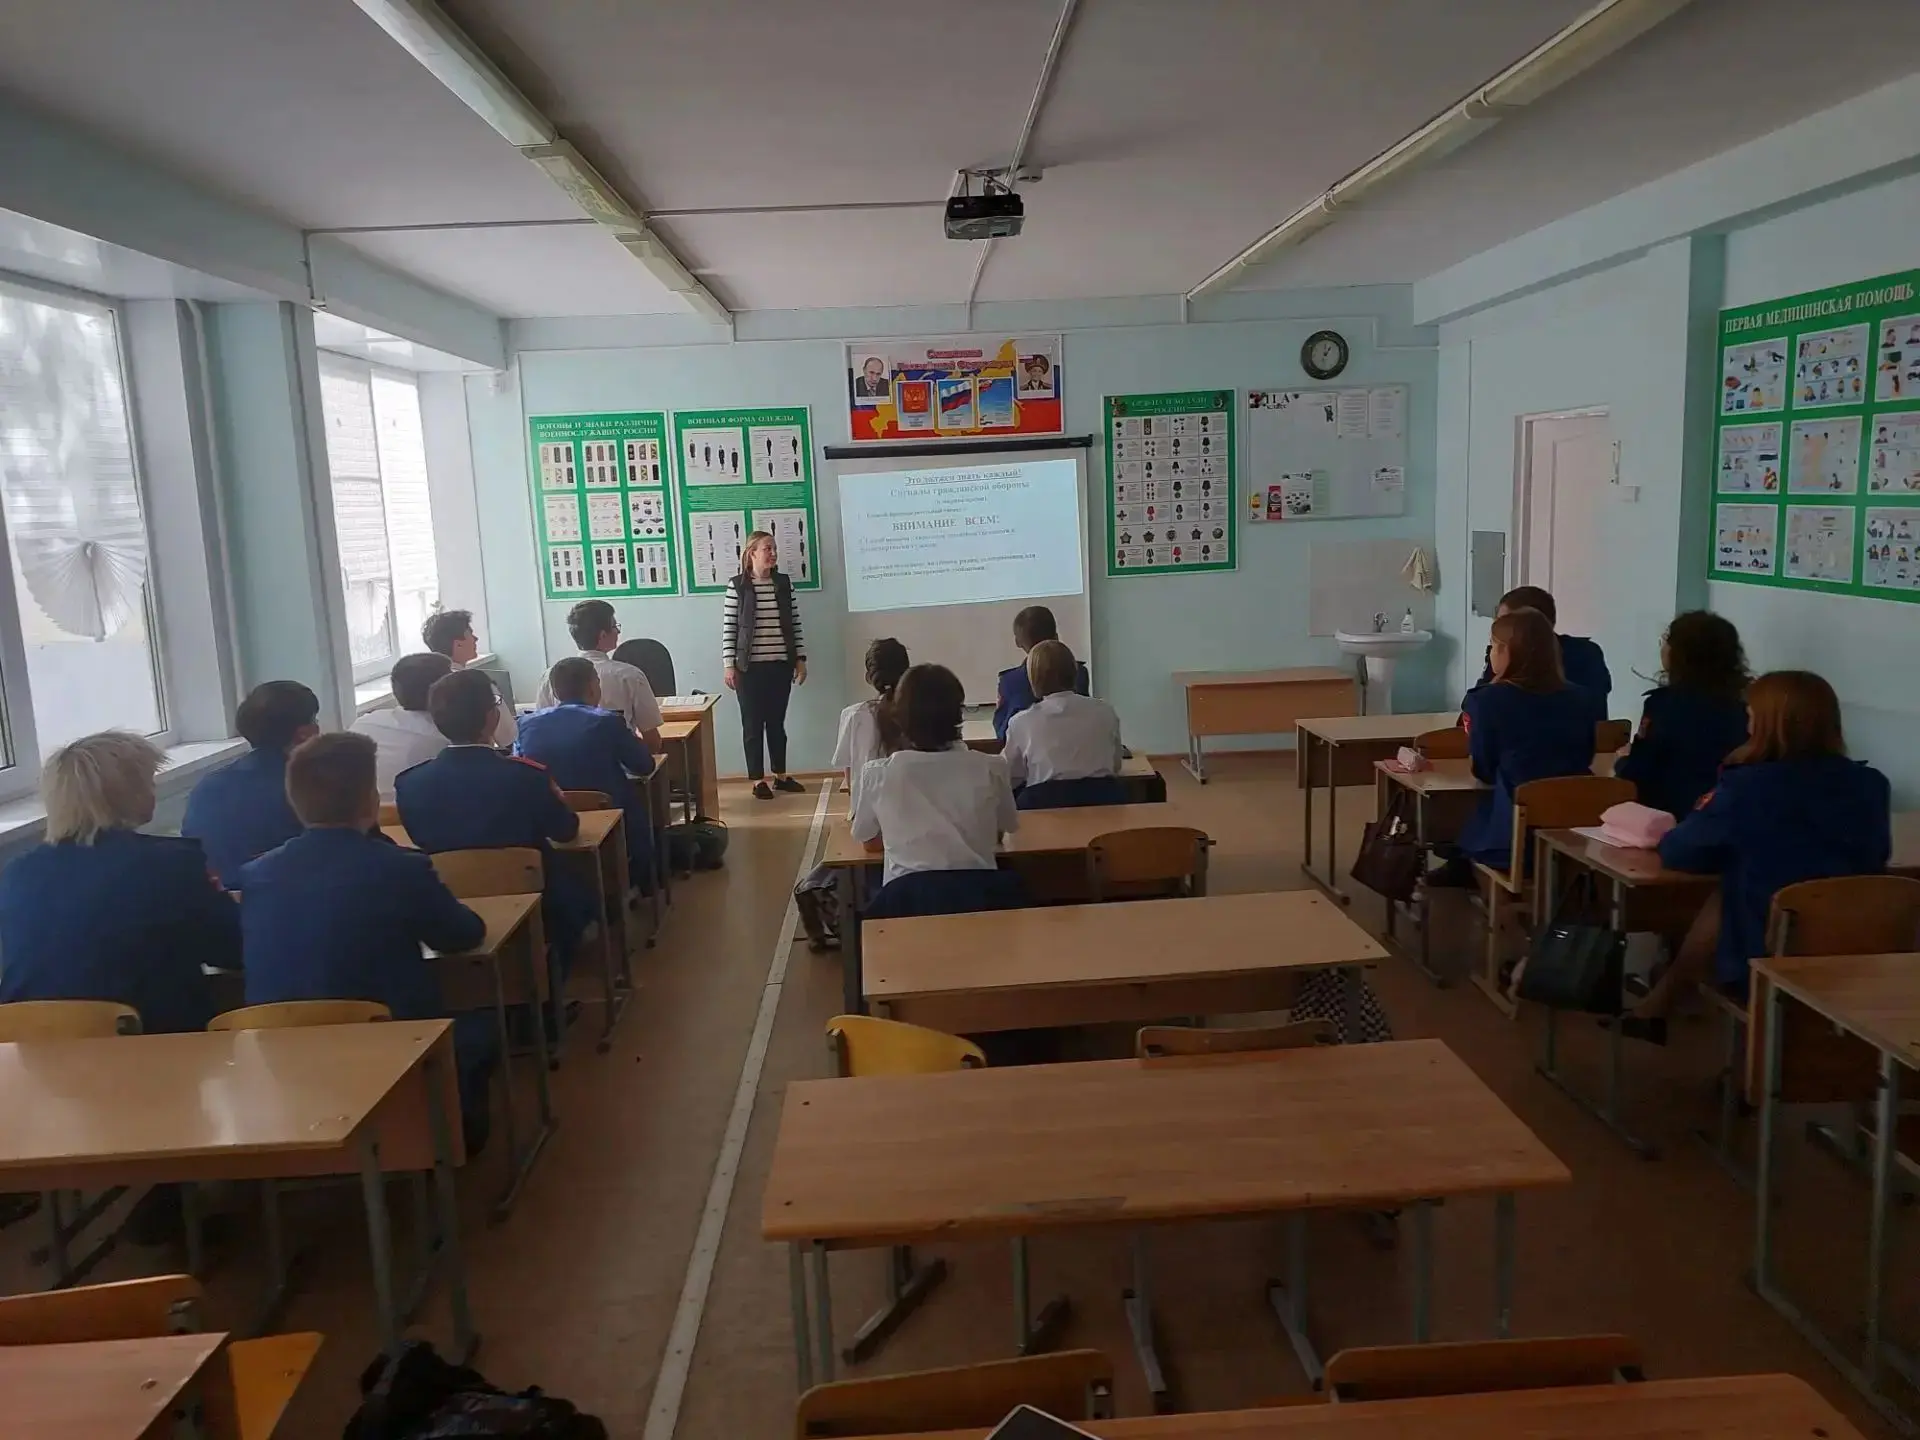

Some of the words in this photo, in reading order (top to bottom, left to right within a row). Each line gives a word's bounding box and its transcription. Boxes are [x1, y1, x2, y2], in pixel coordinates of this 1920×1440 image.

[1725, 314, 1762, 333] ПЕРВАЯ
[1766, 296, 1852, 326] МЕДИЦИНСКАЯ
[1855, 283, 1914, 308] ПОМОЩЬ
[614, 419, 658, 427] РАЗЛИЧИЯ
[688, 417, 726, 425] ВОЕННАЯ
[539, 429, 621, 438] ВОЕННОСЛУЖАЩИХ
[624, 427, 656, 435] РОССИИ
[892, 519, 957, 531] ВНИМАНИЕ
[965, 515, 1000, 526] ВСЕМ!
